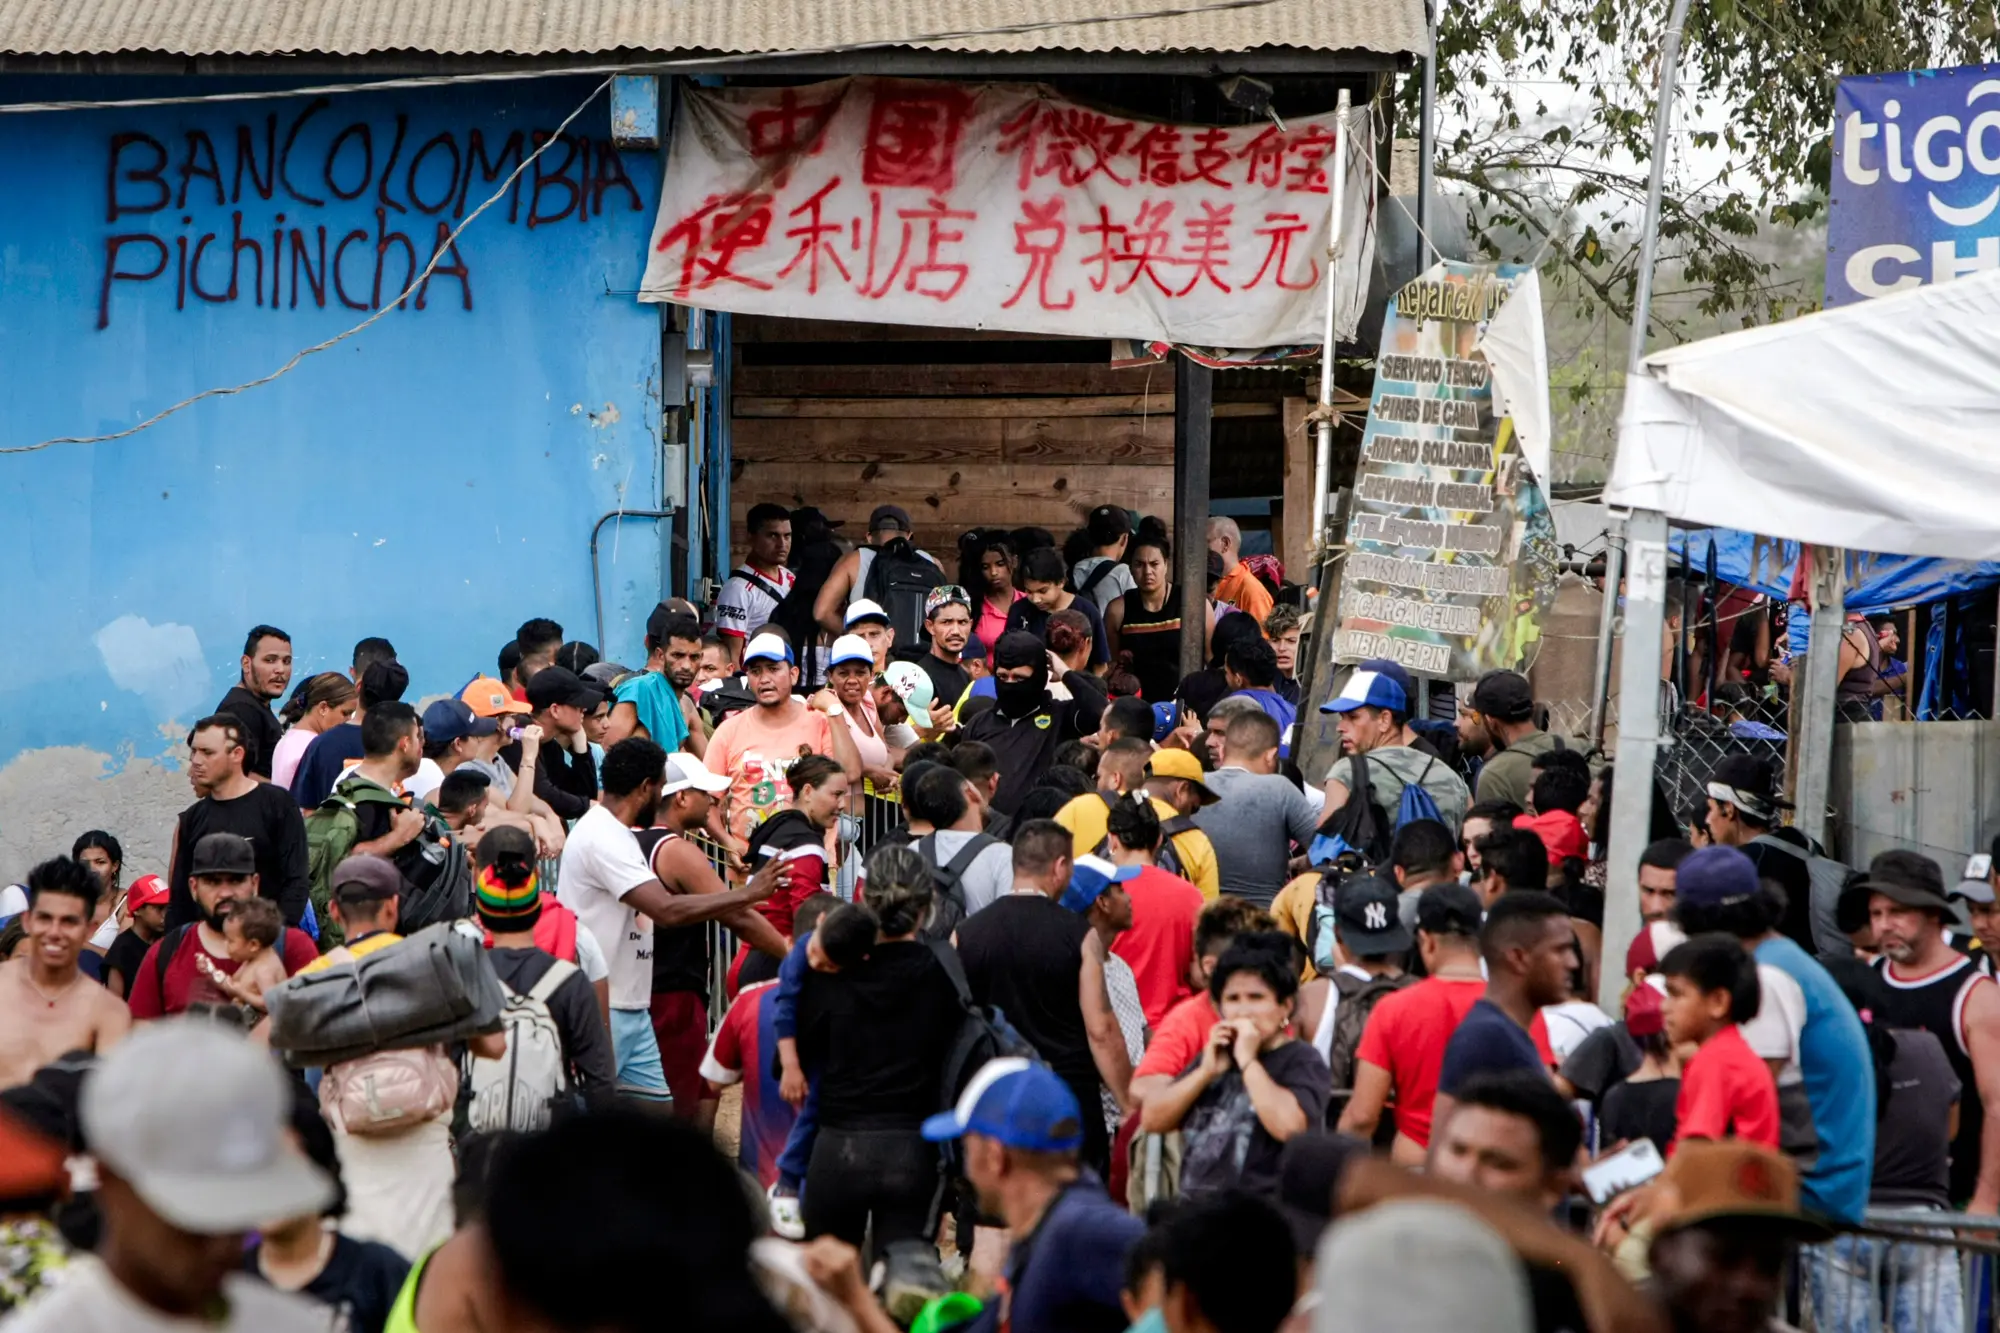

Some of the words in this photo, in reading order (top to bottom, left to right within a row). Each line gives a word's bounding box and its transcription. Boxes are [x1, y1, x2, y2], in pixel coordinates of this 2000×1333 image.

[106, 97, 644, 229] BANCOLOMBIA
[656, 177, 977, 300] 便利店
[999, 198, 1319, 310] 兑换美元
[1422, 399, 1441, 426] DE
[1392, 637, 1416, 665] DE
[1418, 643, 1450, 673] PIN
[1364, 901, 1388, 929] NY
